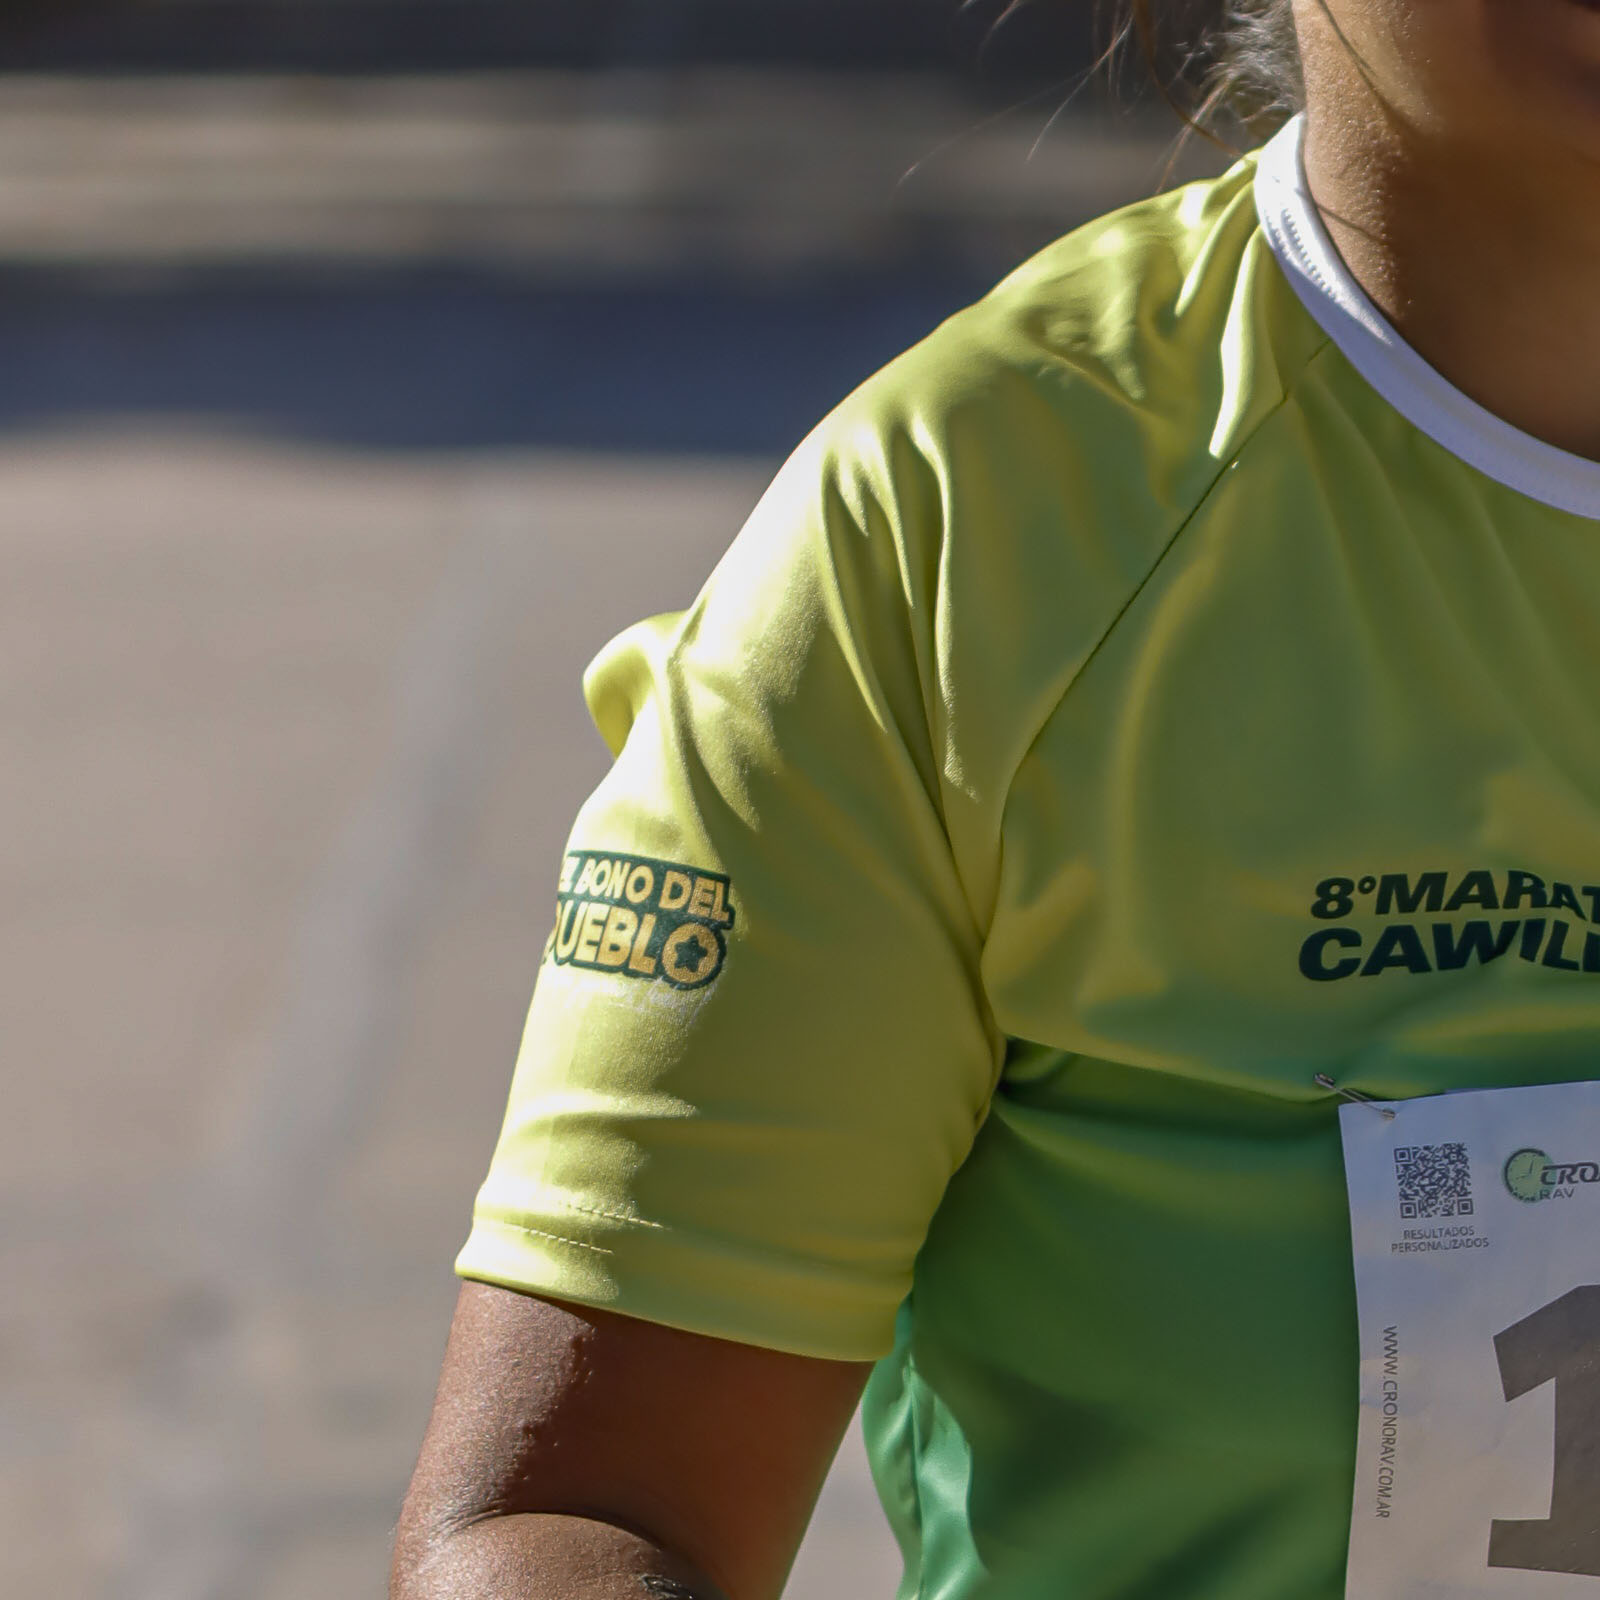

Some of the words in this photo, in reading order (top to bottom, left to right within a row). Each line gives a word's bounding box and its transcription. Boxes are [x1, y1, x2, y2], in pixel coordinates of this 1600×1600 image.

[657, 870, 730, 923] DEL
[553, 900, 721, 984] UEBLO
[1538, 1186, 1577, 1201] RAV
[1391, 1237, 1490, 1254] PERSONALIZADOS
[1402, 1225, 1475, 1241] RESULTADOS
[1374, 1324, 1398, 1519] WWW.CRONORAV.COM.AR
